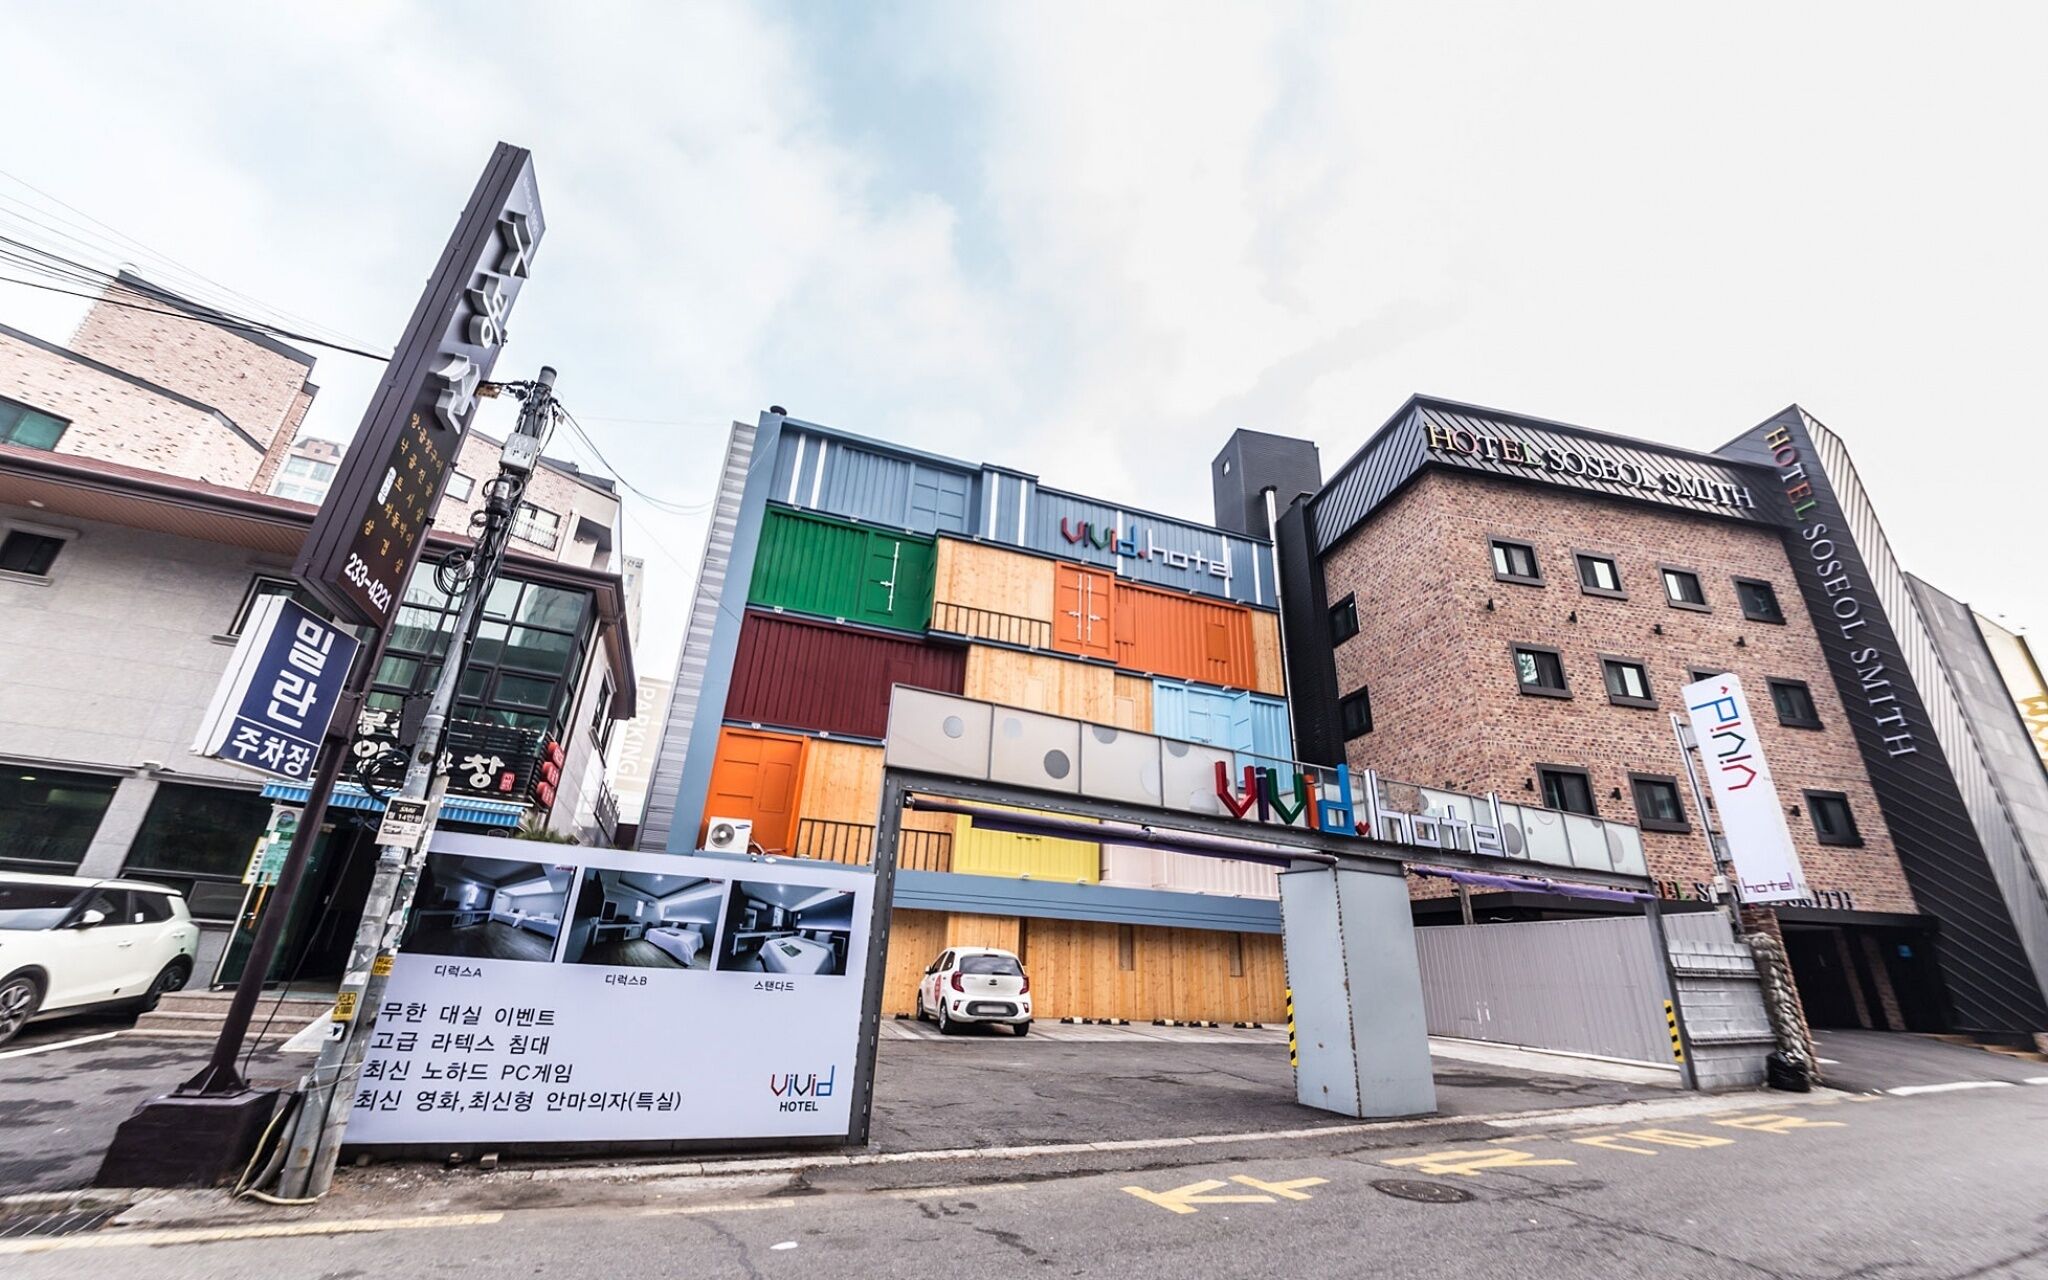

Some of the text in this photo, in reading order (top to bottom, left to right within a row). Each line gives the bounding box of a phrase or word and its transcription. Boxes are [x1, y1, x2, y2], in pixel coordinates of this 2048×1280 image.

[1425, 423, 1756, 509] HOTEL SOSEOL SMITH
[1146, 528, 1233, 580] hotel
[344, 552, 393, 615] 233-4221
[1764, 425, 1918, 760] HOTEL SOSEOL SMITH
[266, 617, 336, 729] 밀란
[231, 725, 311, 776] 주차장
[616, 686, 657, 777] PARKING
[1363, 768, 1509, 857] hotel
[1741, 873, 1794, 895] hotel
[434, 964, 482, 979] 디럭스A
[605, 973, 648, 987] 디럭스B
[381, 1001, 427, 1025] 무한
[440, 1005, 483, 1026] 대실
[494, 1006, 556, 1027] 이벤트
[371, 1031, 550, 1056] 고급 라텍스 침대
[363, 1058, 573, 1084] 최신 노하드 PC게임
[354, 1089, 683, 1114] 최신 영화,최신형 안마의자(특실)
[779, 1101, 819, 1113] HOTEL
